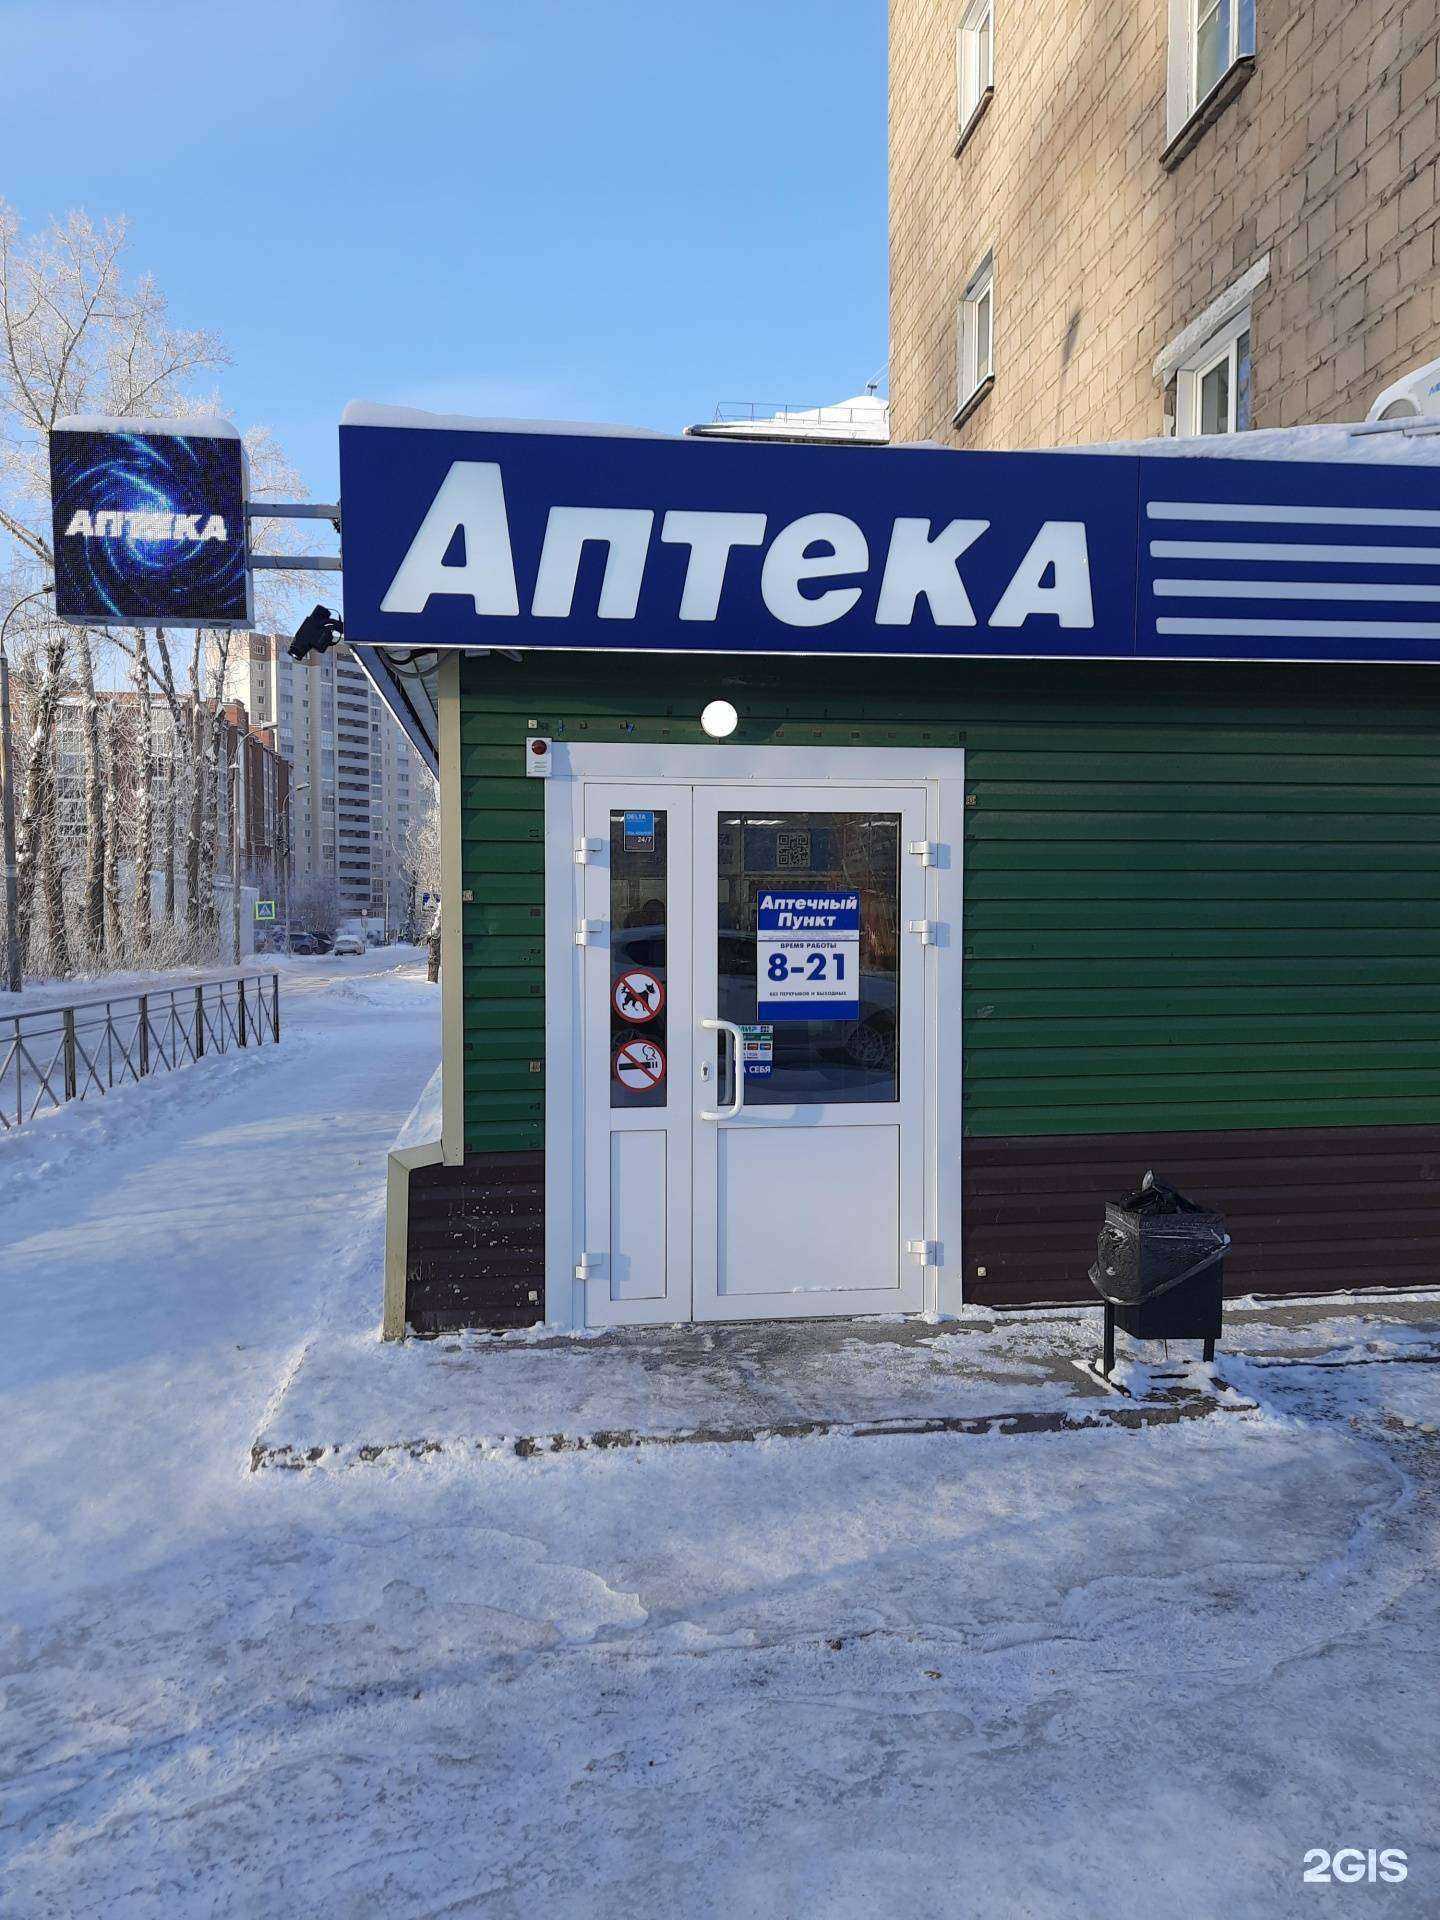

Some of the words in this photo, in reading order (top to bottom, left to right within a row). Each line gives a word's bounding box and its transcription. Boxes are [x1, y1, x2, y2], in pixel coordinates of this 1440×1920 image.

[65, 509, 227, 541] АПТЕКА
[379, 460, 1095, 629] Аптека
[760, 895, 858, 910] Аптечный
[777, 912, 837, 929] Пункт
[749, 1065, 771, 1073] СЕБЯ
